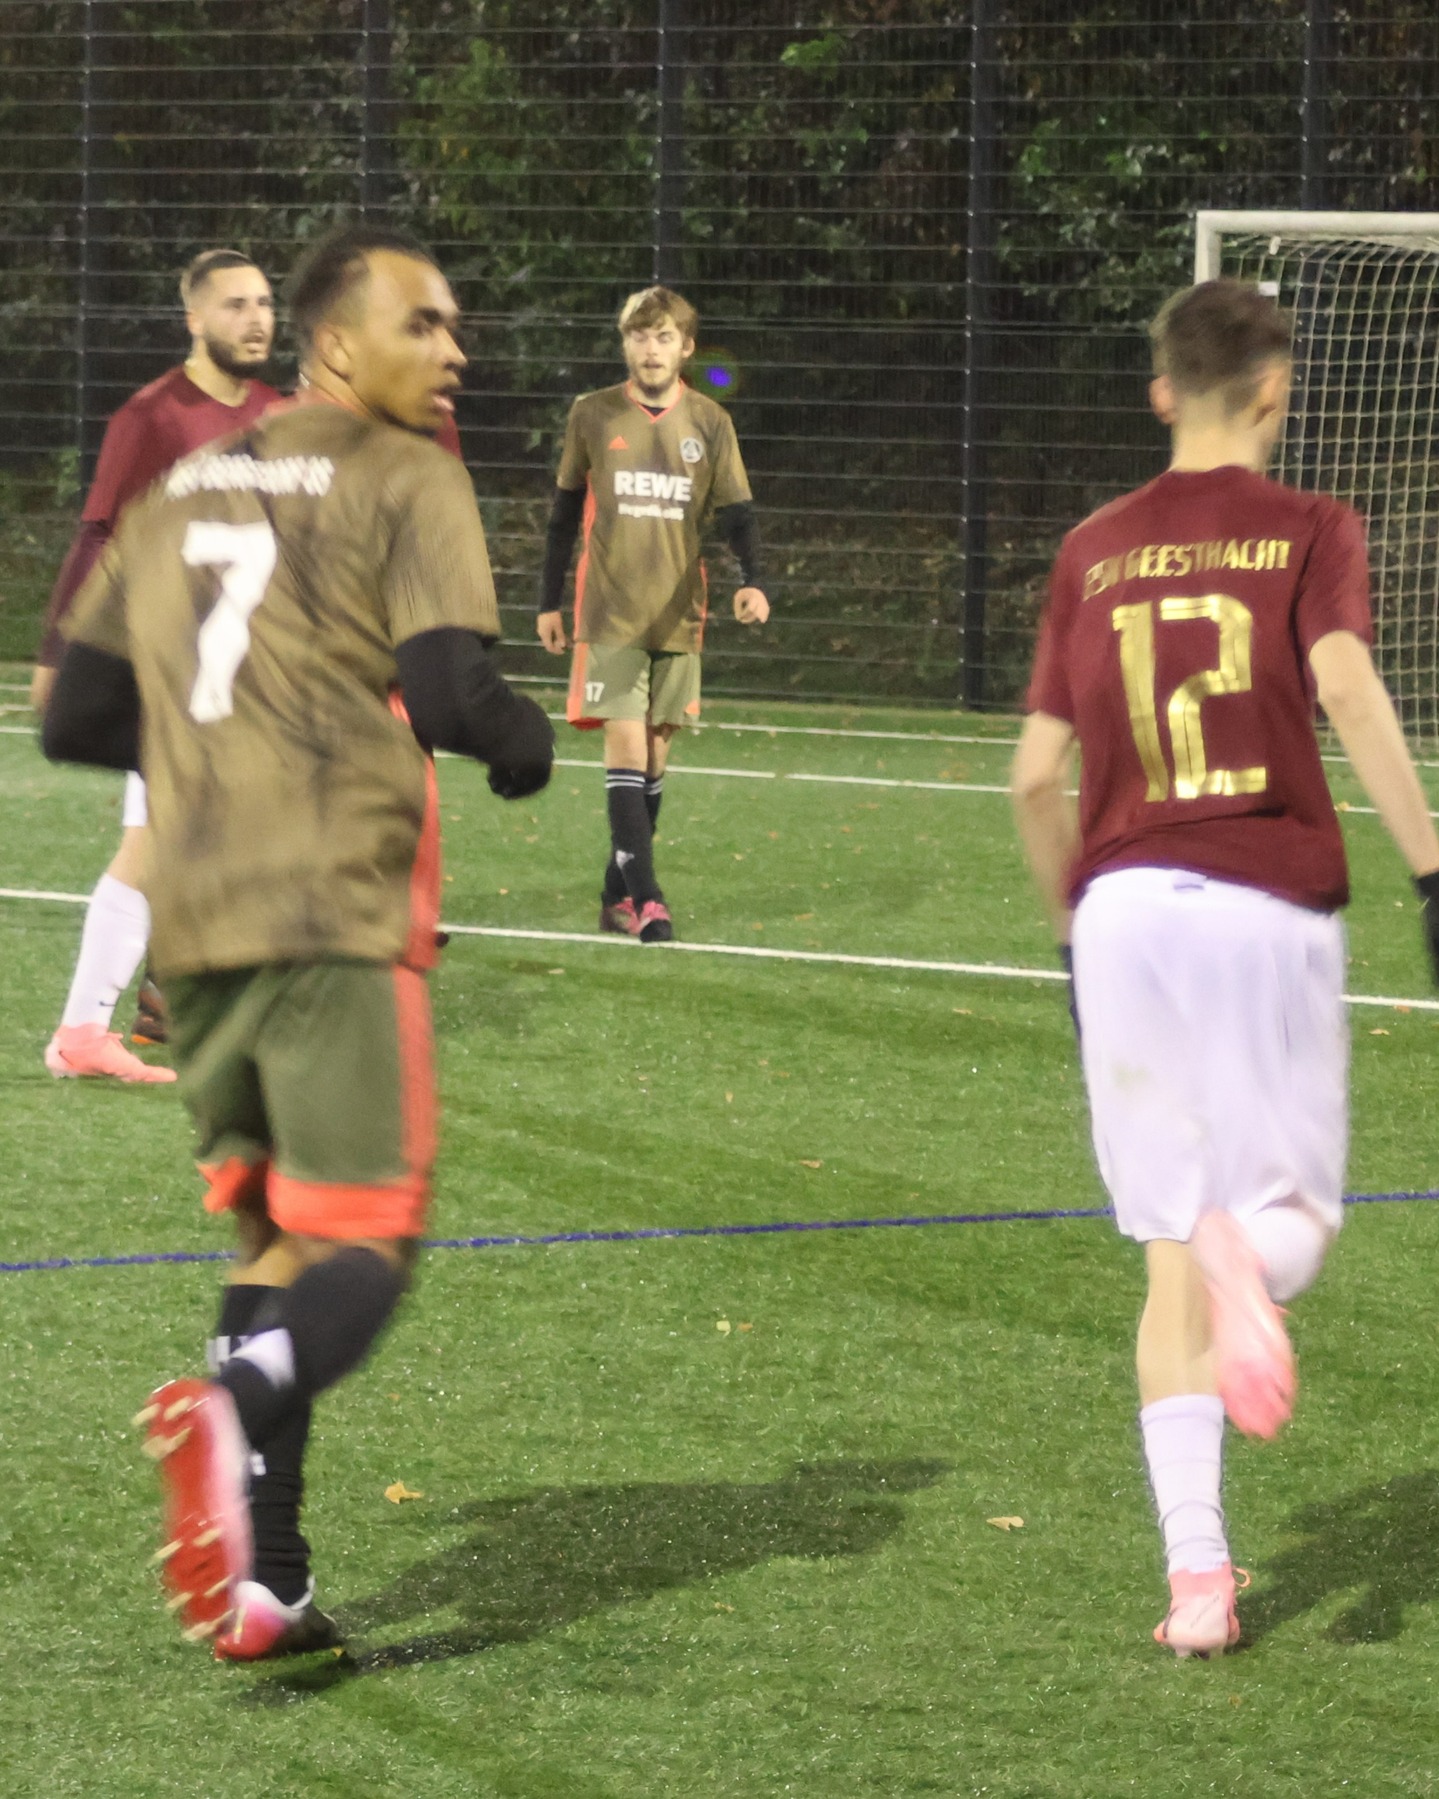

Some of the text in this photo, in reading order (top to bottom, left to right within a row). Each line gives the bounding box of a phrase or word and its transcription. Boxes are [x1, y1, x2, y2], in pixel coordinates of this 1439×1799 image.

[614, 470, 692, 502] REWE
[180, 520, 277, 724] 7
[585, 681, 605, 702] 17
[1112, 593, 1267, 802] 12
